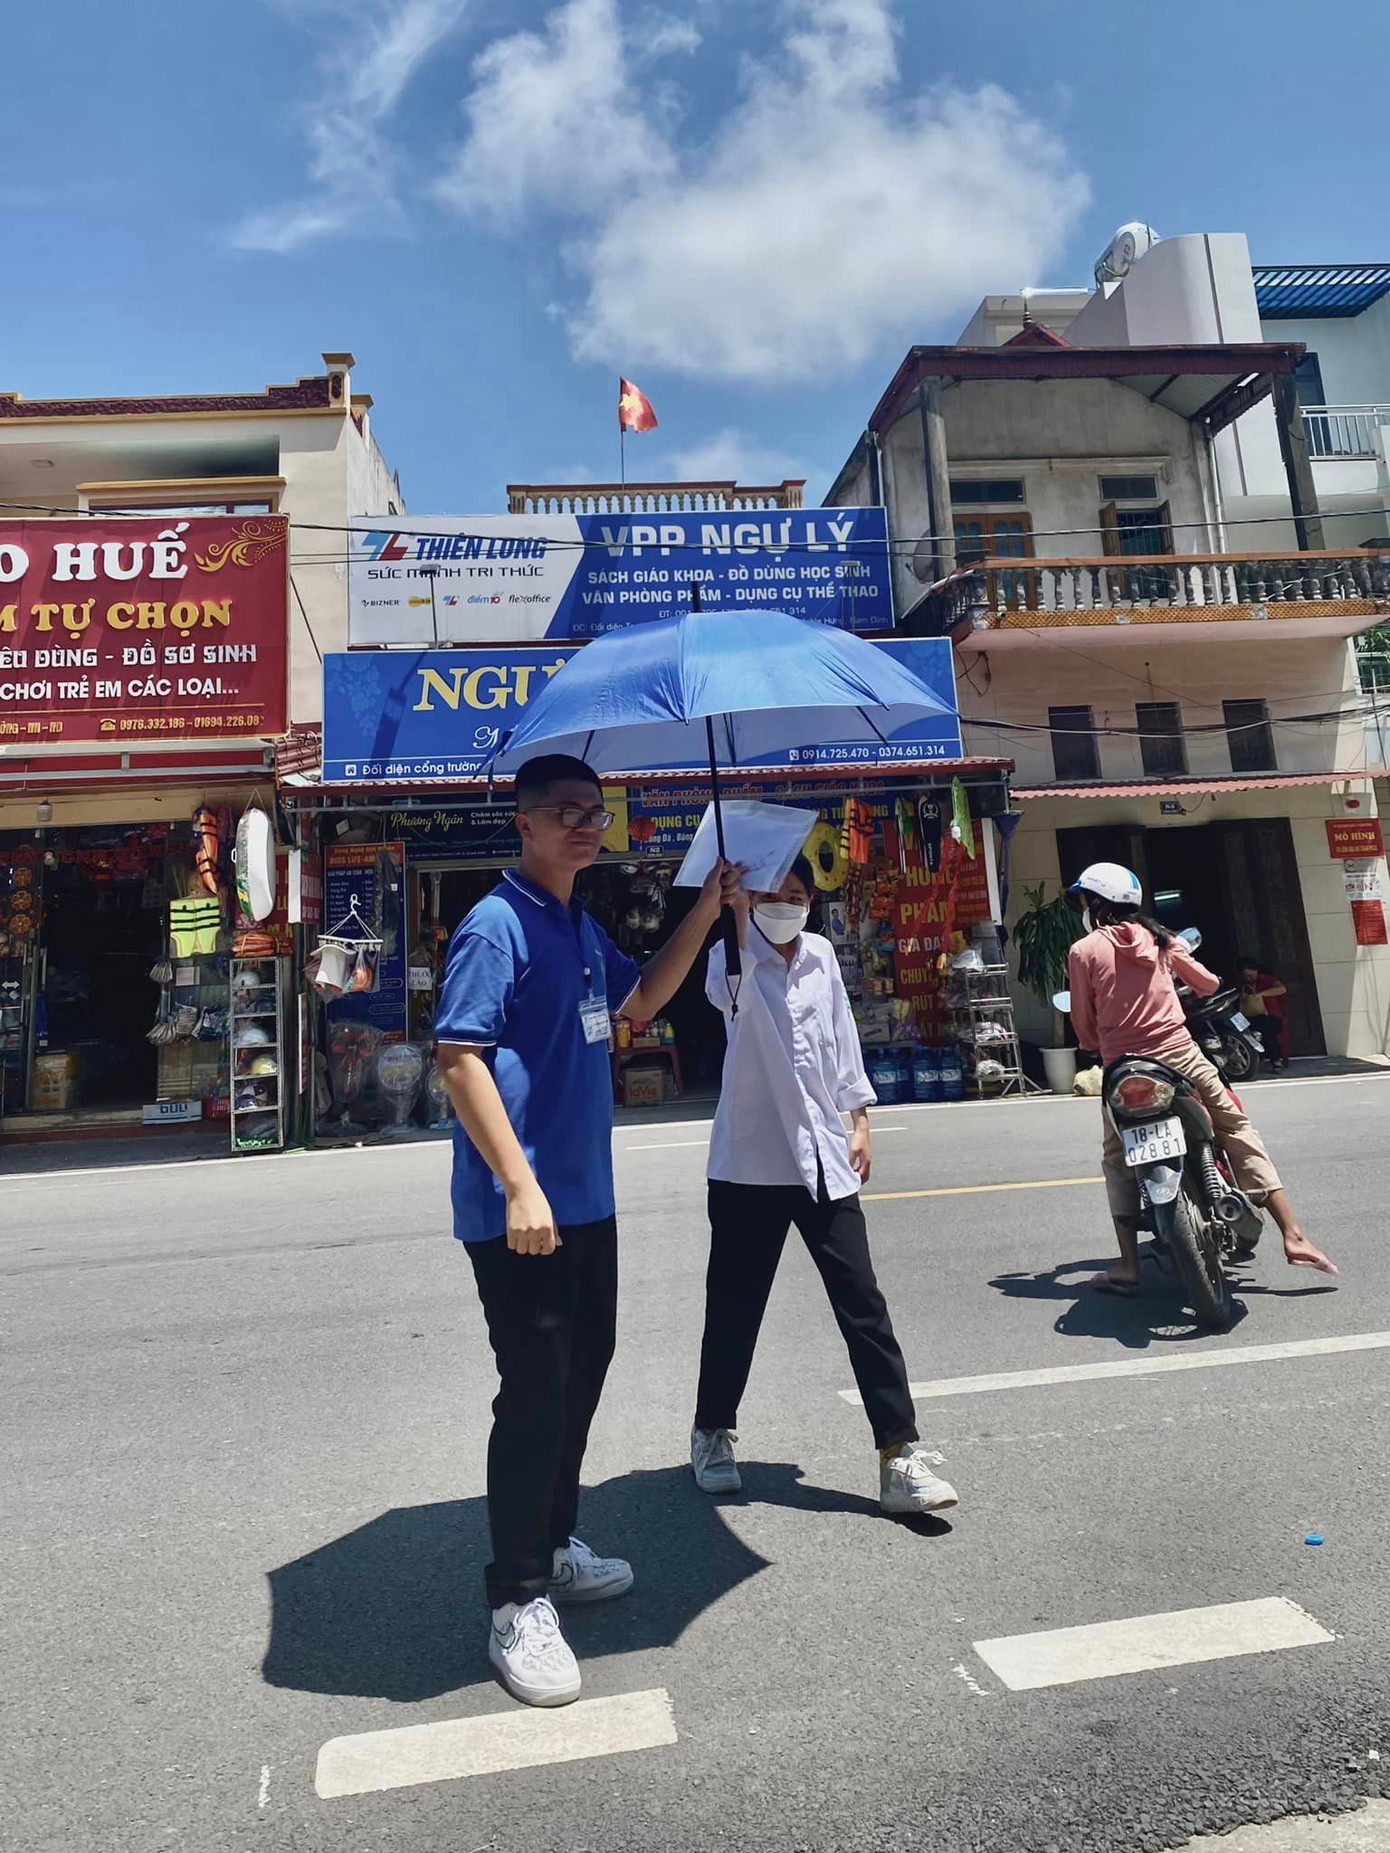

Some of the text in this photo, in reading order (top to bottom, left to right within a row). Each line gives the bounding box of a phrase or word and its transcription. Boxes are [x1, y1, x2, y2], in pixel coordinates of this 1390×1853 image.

[601, 512, 854, 562] VPP NGỰ LÝ
[52, 522, 190, 581] HUẾ
[368, 564, 544, 580] SỨC MNH TRI THỨC
[588, 568, 628, 584] SÁCH
[633, 567, 669, 583] GIÁO
[674, 569, 714, 583] KHOA
[728, 563, 749, 581] ĐỒ
[754, 565, 796, 580] DÙNG
[801, 567, 830, 582] HỌC
[835, 565, 871, 578] SINH
[620, 588, 672, 604] PHÒNG
[736, 587, 777, 603] DỤNG
[783, 587, 803, 602] CỤ
[807, 581, 835, 598] THỂ
[840, 585, 878, 598] THAO
[31, 598, 96, 639] TỰ
[106, 600, 232, 637] CHỌN
[34, 644, 98, 668] DÙNG
[122, 638, 156, 666] ĐỒ
[164, 643, 196, 665] SƠ
[203, 644, 257, 664] SINH
[0, 673, 240, 700] CHƠI TRẺ EM CÁC LOẠI...
[802, 747, 869, 760] 0914.725.470
[878, 745, 945, 758] 0374.651.314
[362, 763, 382, 776] Đối
[386, 763, 411, 777] diện
[414, 760, 444, 776] cổng
[391, 811, 465, 832] Phương Ngân
